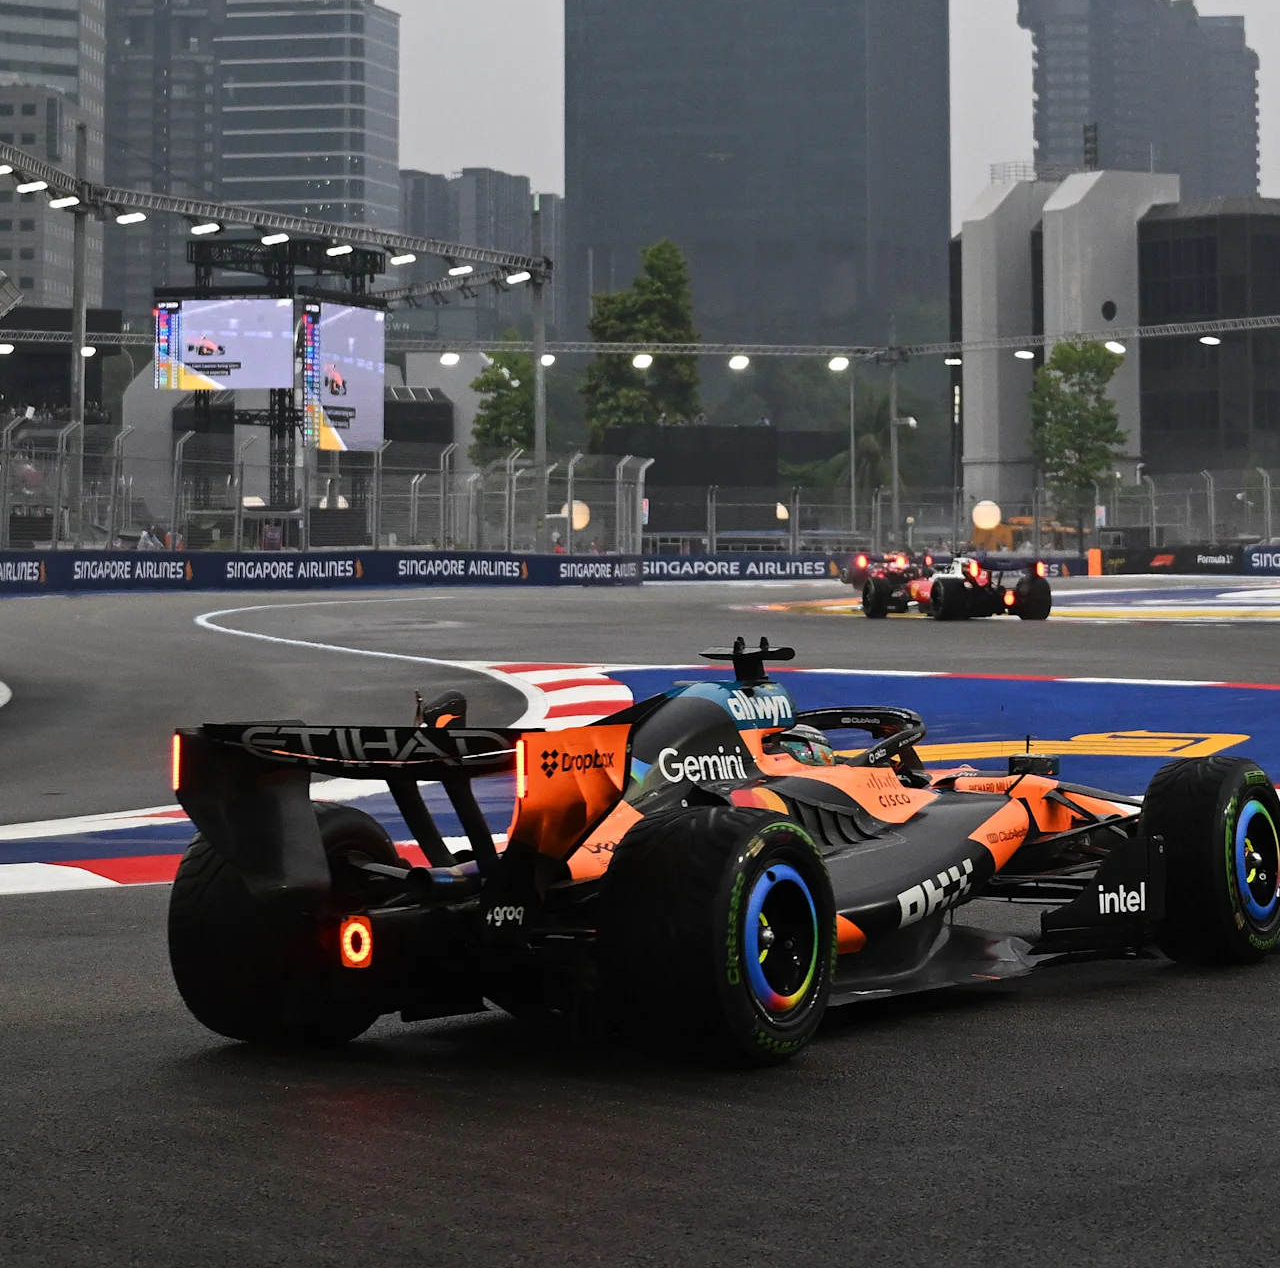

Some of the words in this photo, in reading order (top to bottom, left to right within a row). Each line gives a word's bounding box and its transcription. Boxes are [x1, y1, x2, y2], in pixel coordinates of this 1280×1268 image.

[74, 560, 131, 579] SINGAPORE
[135, 560, 184, 579] AIRLINES
[226, 562, 294, 578] SINGAPORE
[298, 560, 354, 578] AIRLINES
[399, 560, 465, 575] SINGAPORE
[469, 560, 521, 576] AIRLINES
[643, 561, 739, 575] SINGAPORE
[746, 561, 826, 575] AIRLINES
[1197, 554, 1226, 564] Formula
[560, 563, 612, 578] SINGAPORE
[727, 690, 793, 726] allwyn
[240, 726, 515, 768] ETIHAD
[562, 749, 615, 774] Dropbox
[658, 745, 748, 783] Gemini
[1097, 881, 1147, 915] intel
[493, 905, 526, 928] groq
